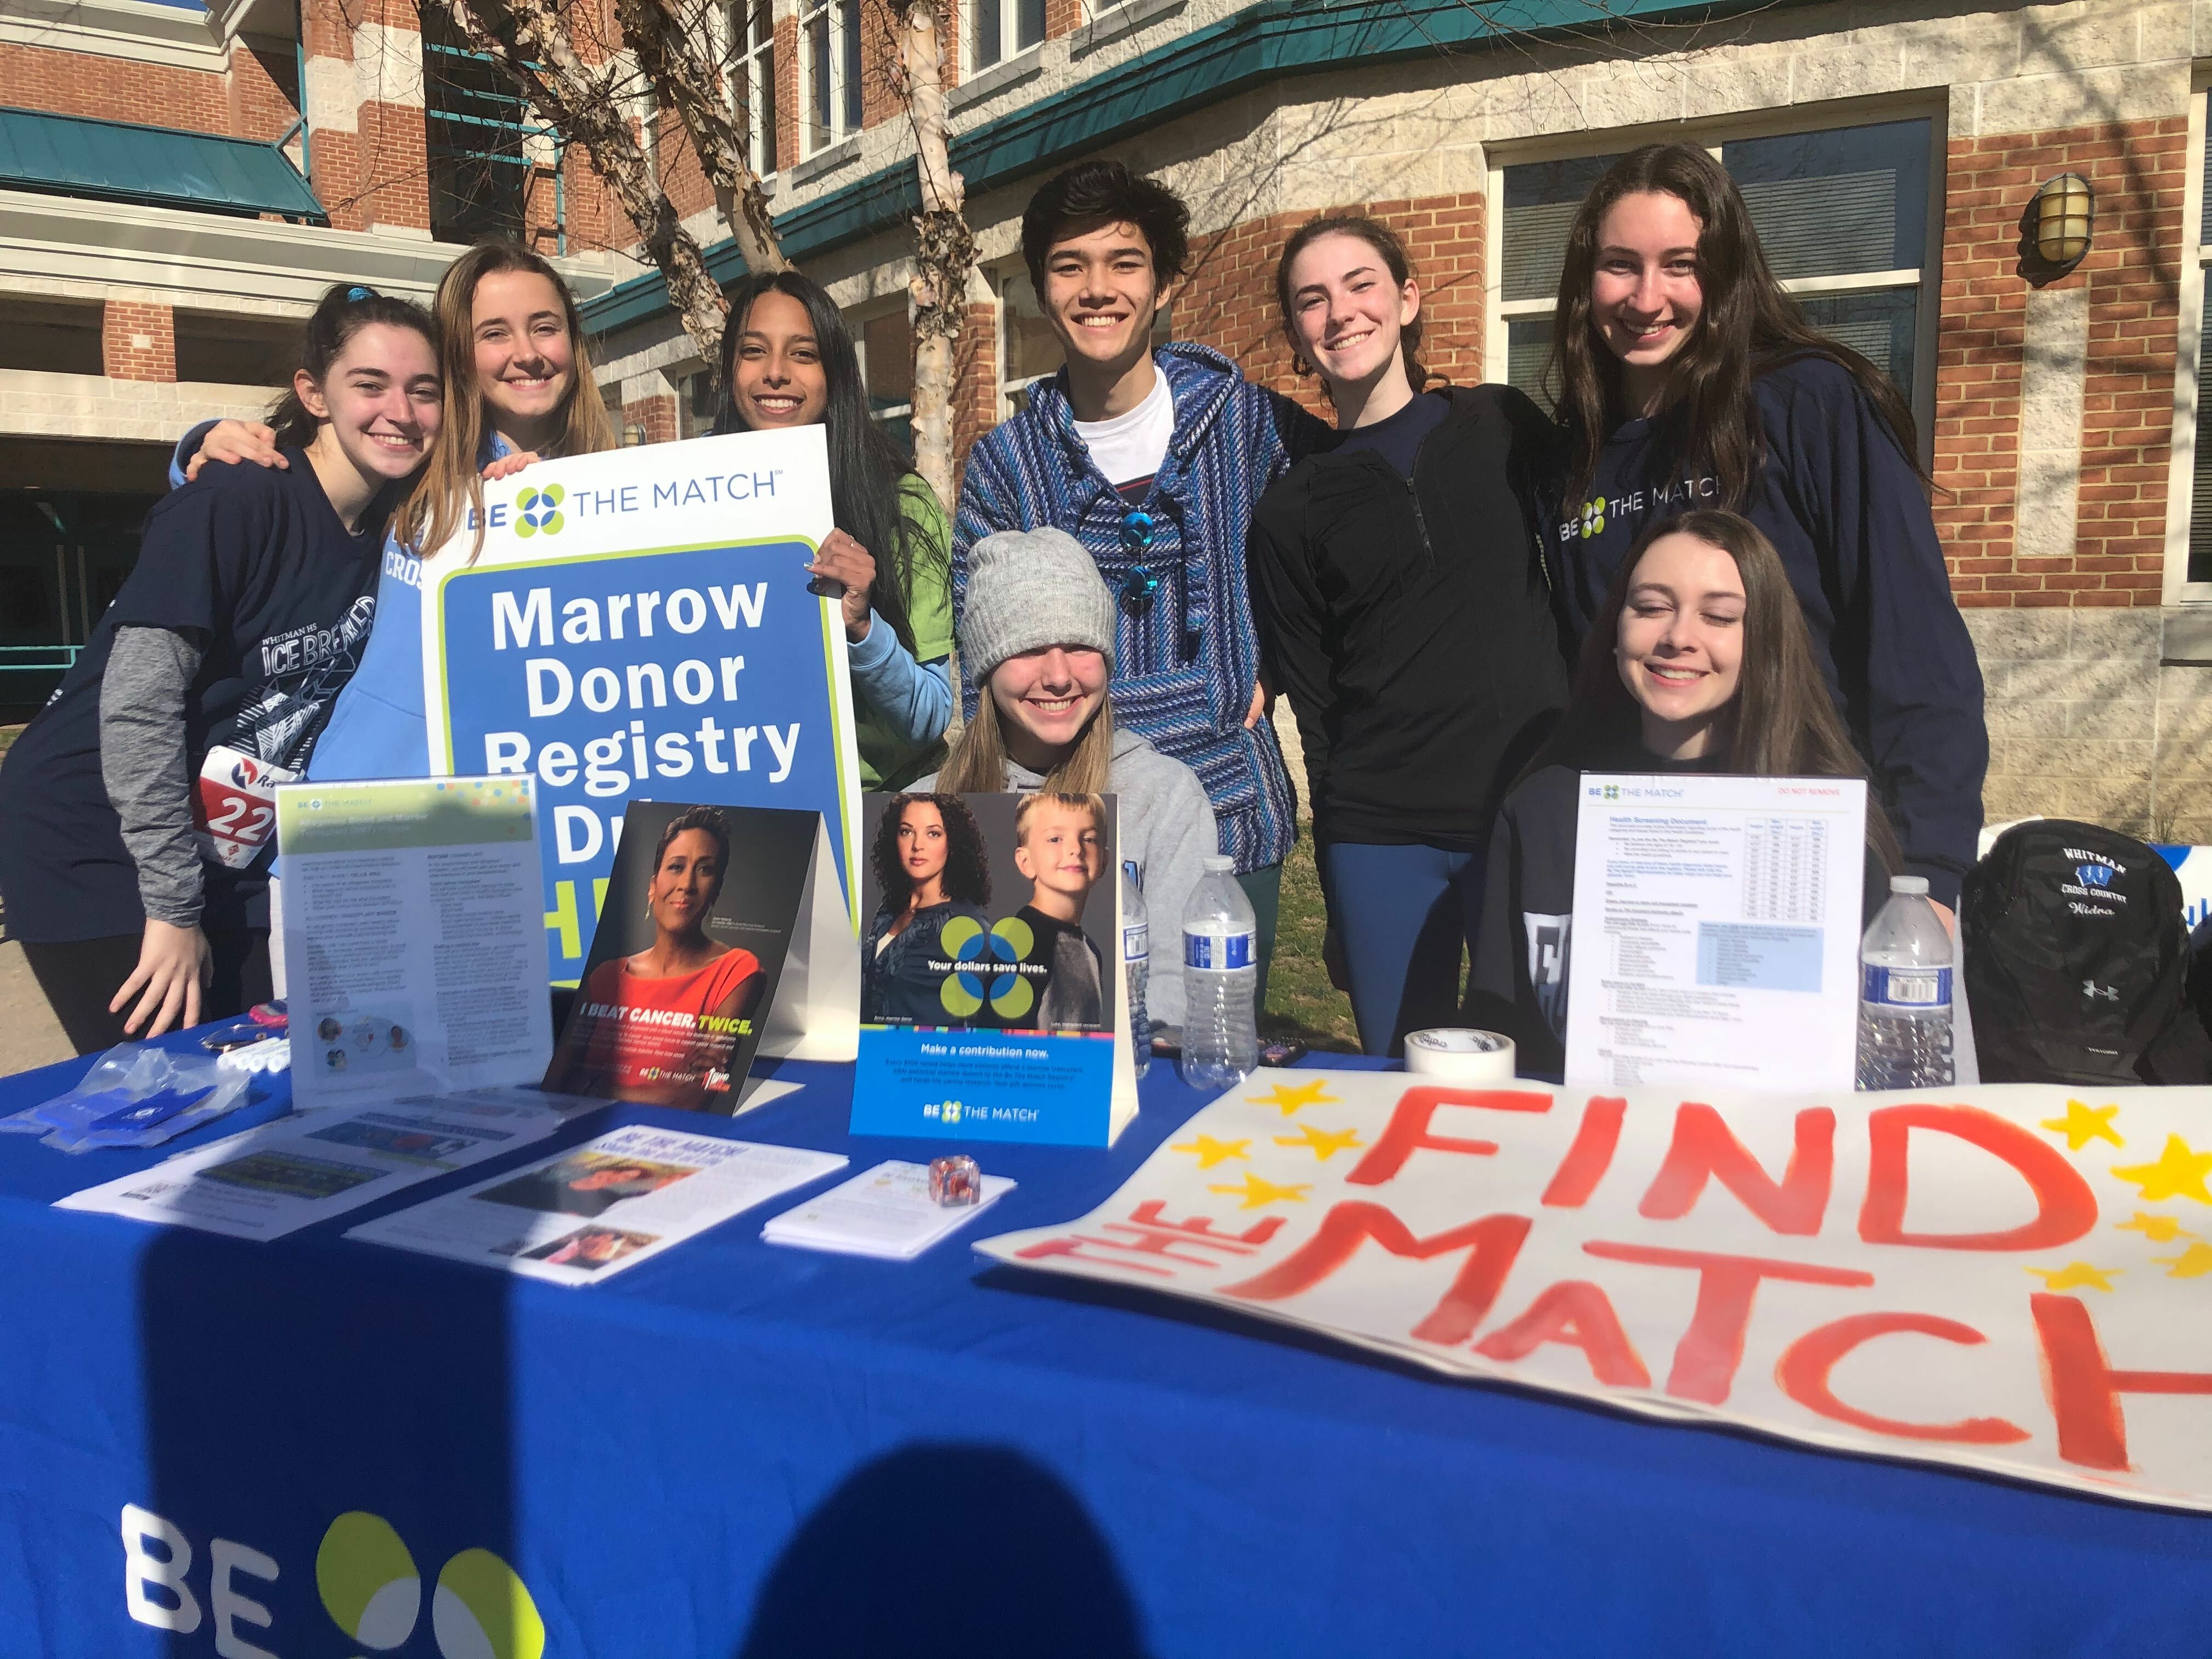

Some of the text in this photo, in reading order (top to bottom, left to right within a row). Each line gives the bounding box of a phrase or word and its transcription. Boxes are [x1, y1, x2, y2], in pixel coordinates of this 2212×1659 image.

[467, 471, 776, 531] BE THE MATCH
[1559, 517, 1578, 542] BE
[1609, 491, 1645, 518] THE
[262, 623, 317, 646] WHITMAN HS
[492, 582, 768, 651] Marrow
[262, 639, 300, 676] ICE
[525, 655, 746, 718] Donor
[484, 716, 801, 797] Registry
[1621, 788, 1641, 796] THE
[1645, 789, 1683, 798] MATCH
[2063, 848, 2127, 874] WHITMAN
[2061, 883, 2128, 904] CROSS COUNTRY
[927, 960, 1048, 974] Your dollars save lives.
[579, 1001, 753, 1035] I BEAT CANCER. TWICE.
[921, 1043, 1049, 1060] Make a contribution now.
[923, 1104, 1037, 1123] BE THE MATCH
[1344, 1086, 2099, 1252] FIND
[1014, 1199, 2212, 1472] THE MATCH
[121, 1502, 282, 1659] BE
